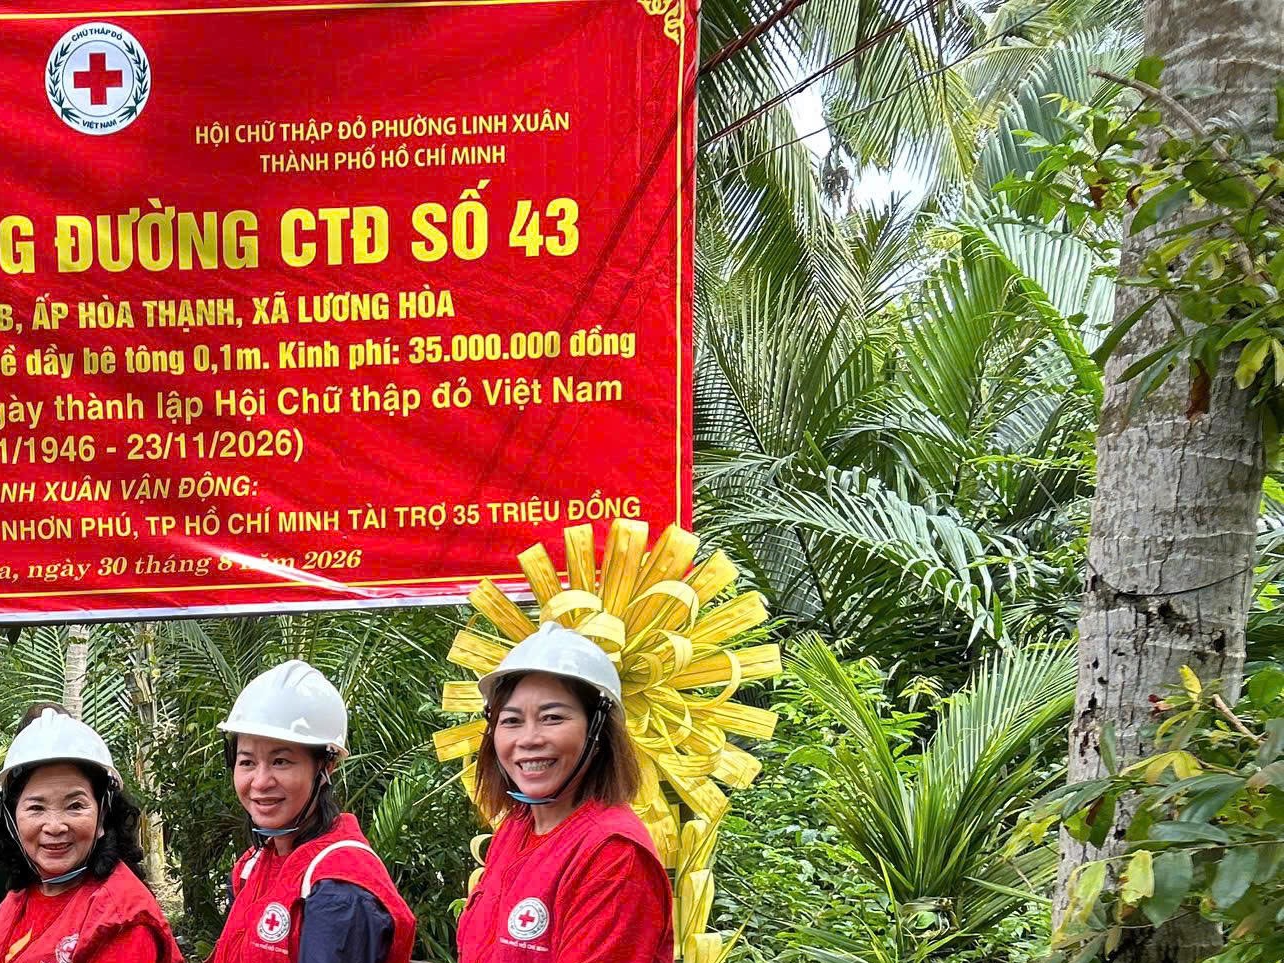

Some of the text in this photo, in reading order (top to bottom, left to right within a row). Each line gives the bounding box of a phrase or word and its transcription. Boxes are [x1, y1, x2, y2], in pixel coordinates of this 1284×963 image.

[196, 109, 569, 147] HỘI CHỮ THẬP ĐỎ PHƯỜNG LINH XUÂN
[260, 143, 505, 172] THÀNH PHỐ HỒ CHÍ MINH
[55, 198, 258, 272] ĐƯỜNG
[281, 206, 388, 267] CTĐ
[412, 179, 490, 262] SỐ
[509, 198, 579, 256] 43
[32, 293, 69, 330] ẤP
[78, 295, 134, 328] HÒA
[142, 299, 242, 332] THẠNH,
[252, 291, 289, 324] XÃ
[298, 292, 389, 322] LƯƠNG
[399, 284, 455, 319] HÒA
[26, 344, 73, 378] dầy
[84, 346, 115, 374] bê
[125, 345, 184, 375] tông
[194, 344, 269, 374] 0,1m.
[279, 341, 339, 368] Kinh
[349, 337, 399, 370] phí:
[409, 331, 560, 363] 35.000.000
[570, 325, 635, 358] đồng
[54, 393, 143, 420] thành
[158, 391, 203, 424] lập
[216, 389, 265, 421] Hội
[278, 386, 342, 415] Chữ
[350, 383, 420, 417] thập
[432, 377, 471, 408] đỏ
[482, 378, 542, 410] Việt
[553, 376, 622, 403] Nam
[128, 428, 303, 462] 23/11/2026)
[43, 475, 111, 501] XUÂN
[121, 473, 170, 504] VẬN
[179, 471, 257, 501] ĐỘNG:
[2, 516, 71, 540] NHƠN
[81, 512, 138, 539] PHÚ,
[145, 516, 176, 535] TP
[185, 506, 220, 535] HỒ
[228, 507, 270, 534] CHÍ
[279, 511, 338, 532] MINH
[348, 503, 386, 529] TÀI
[394, 502, 446, 530] TRỢ
[454, 504, 479, 525] 35
[487, 496, 559, 526] TRIỆU
[568, 490, 640, 520] ĐỒNG
[28, 559, 91, 581] ngày
[98, 557, 127, 575] 30
[136, 555, 212, 576] tháng
[218, 554, 233, 571] 8
[302, 550, 362, 569] 2026
